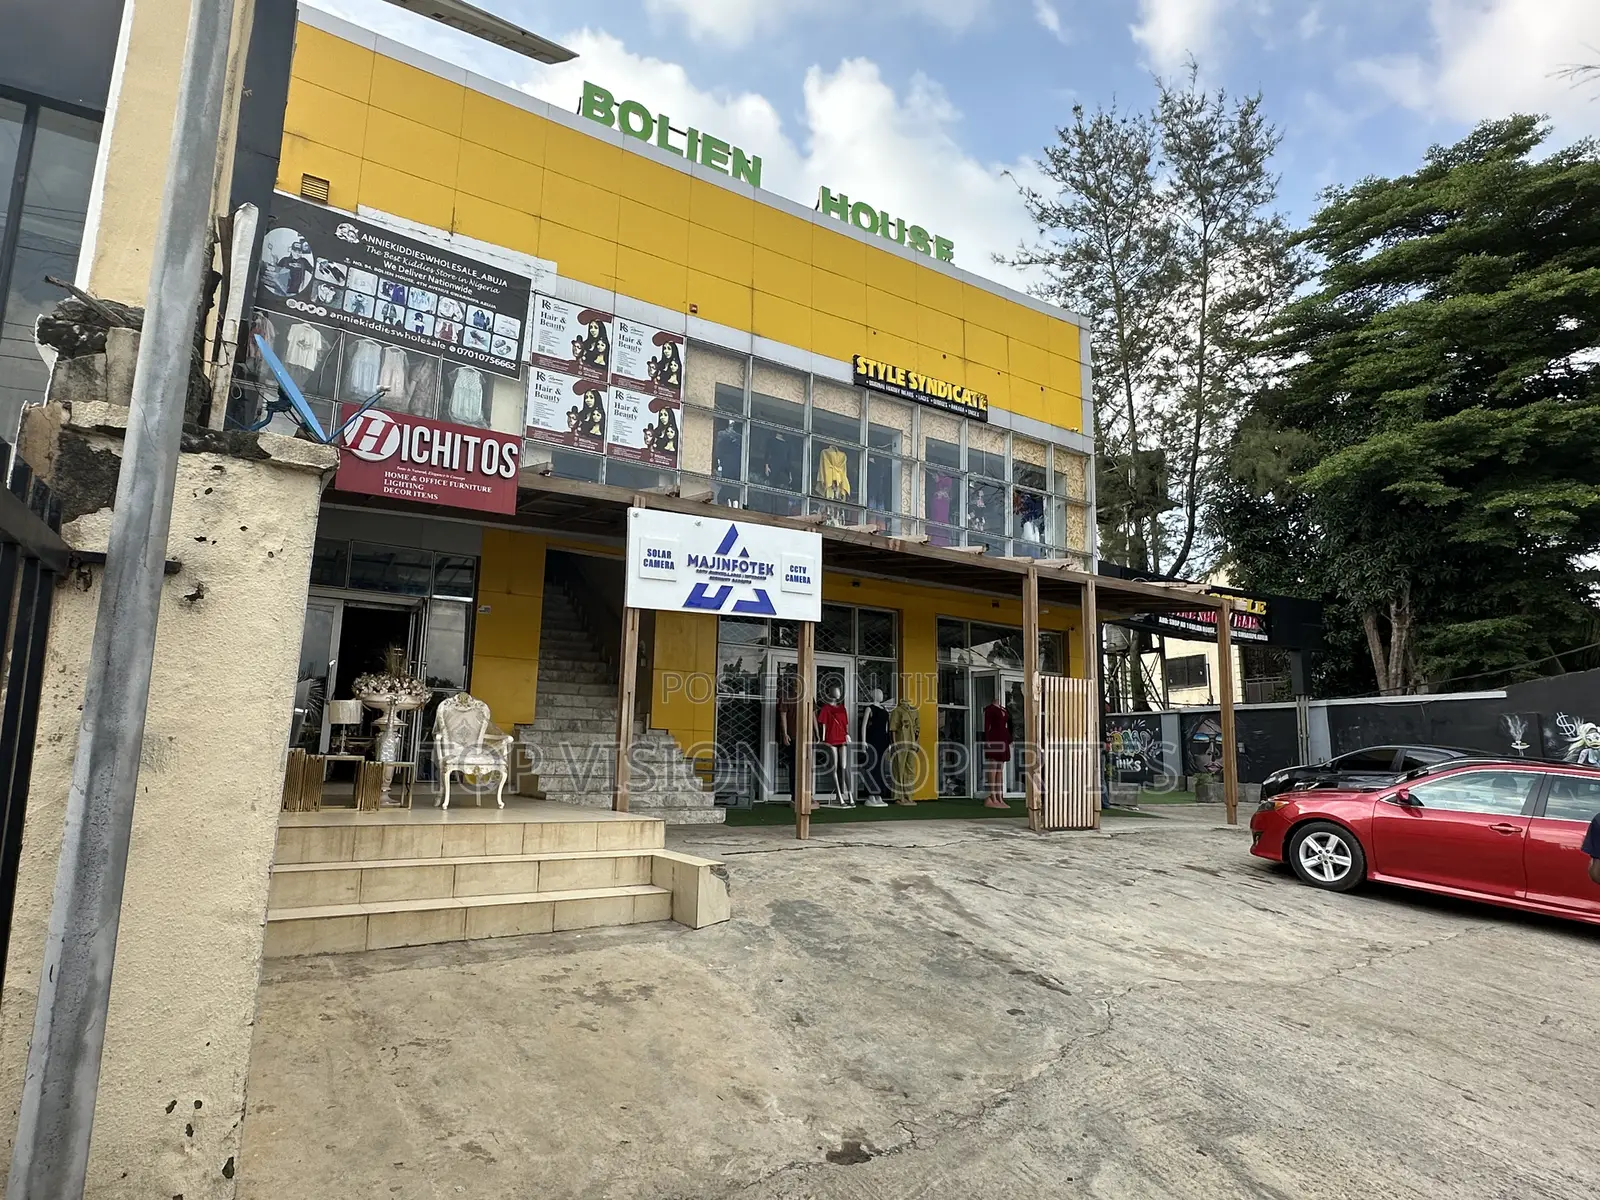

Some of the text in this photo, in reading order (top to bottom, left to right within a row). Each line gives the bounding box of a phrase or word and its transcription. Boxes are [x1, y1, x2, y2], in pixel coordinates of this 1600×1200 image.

[582, 80, 955, 264] BOLIEN HOUSE
[366, 244, 383, 256] The
[383, 251, 401, 263] Best
[435, 268, 457, 280] Store
[468, 279, 501, 295] Nigeria
[383, 260, 473, 296] We Deliver Nationwide
[540, 311, 558, 321] Hair
[329, 312, 446, 350] anniekiddieswholesale
[540, 318, 566, 332] Beauty
[618, 333, 635, 343] Hair
[618, 340, 642, 353] Beauty
[535, 383, 553, 393] Hair
[856, 356, 988, 411] STYLE SYNDICATE
[534, 390, 560, 404] Beauty
[614, 401, 631, 411] Hair
[613, 409, 637, 421] Beauty
[384, 471, 409, 481] HOME
[419, 475, 449, 488] OFFICE
[449, 481, 493, 494] FURNITURE
[384, 478, 424, 491] LIGHTING
[383, 486, 438, 500] DECOR ITEMS
[647, 548, 672, 559] SOLAR
[643, 558, 675, 570] CAMERA
[687, 553, 775, 577] MAJINFOTEK
[789, 564, 807, 574] CCTV
[785, 573, 811, 584] CAMERA
